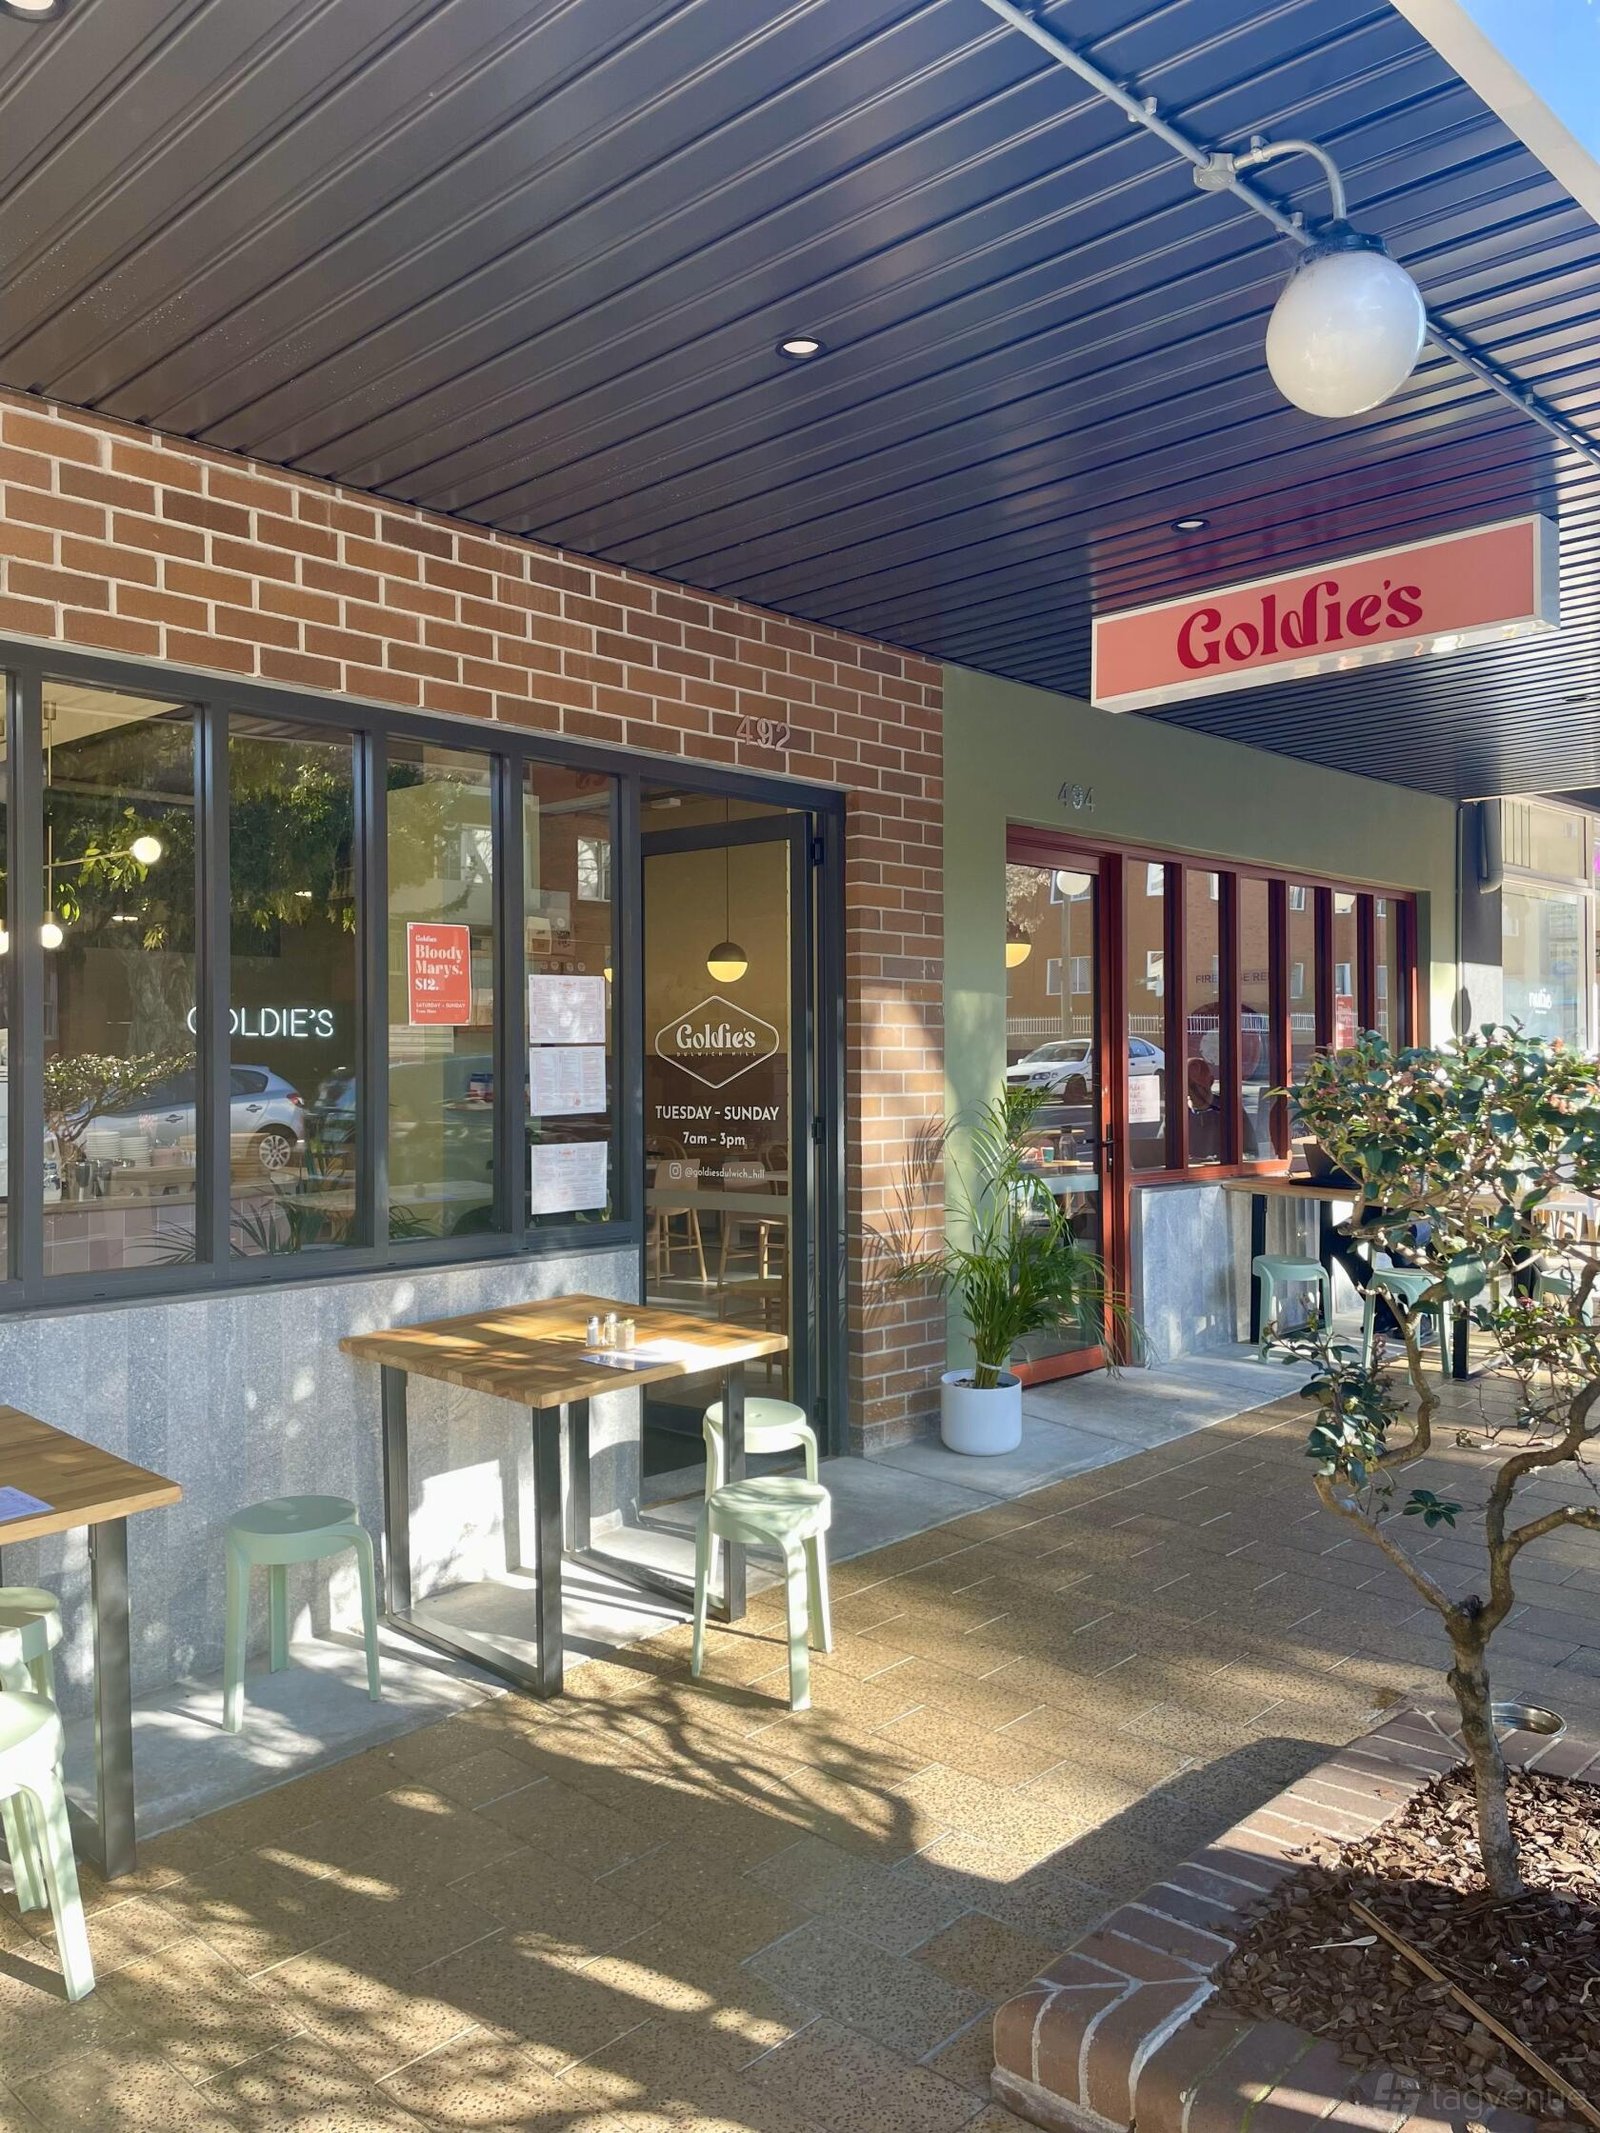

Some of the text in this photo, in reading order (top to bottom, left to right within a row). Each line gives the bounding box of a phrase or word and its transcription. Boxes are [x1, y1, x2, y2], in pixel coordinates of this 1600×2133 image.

[1177, 580, 1423, 669] Goldie's
[736, 715, 790, 751] 492
[1057, 781, 1096, 812] 494
[415, 944, 463, 963] Bloody
[415, 960, 463, 978] Marys.
[676, 1023, 757, 1049] Goldie's
[655, 1105, 712, 1119] TUESDAY
[724, 1106, 779, 1120] SUNDAY
[682, 1131, 708, 1145] 7am
[720, 1132, 745, 1148] 3pm
[684, 1167, 765, 1179] @goldiesdulwich_hill
